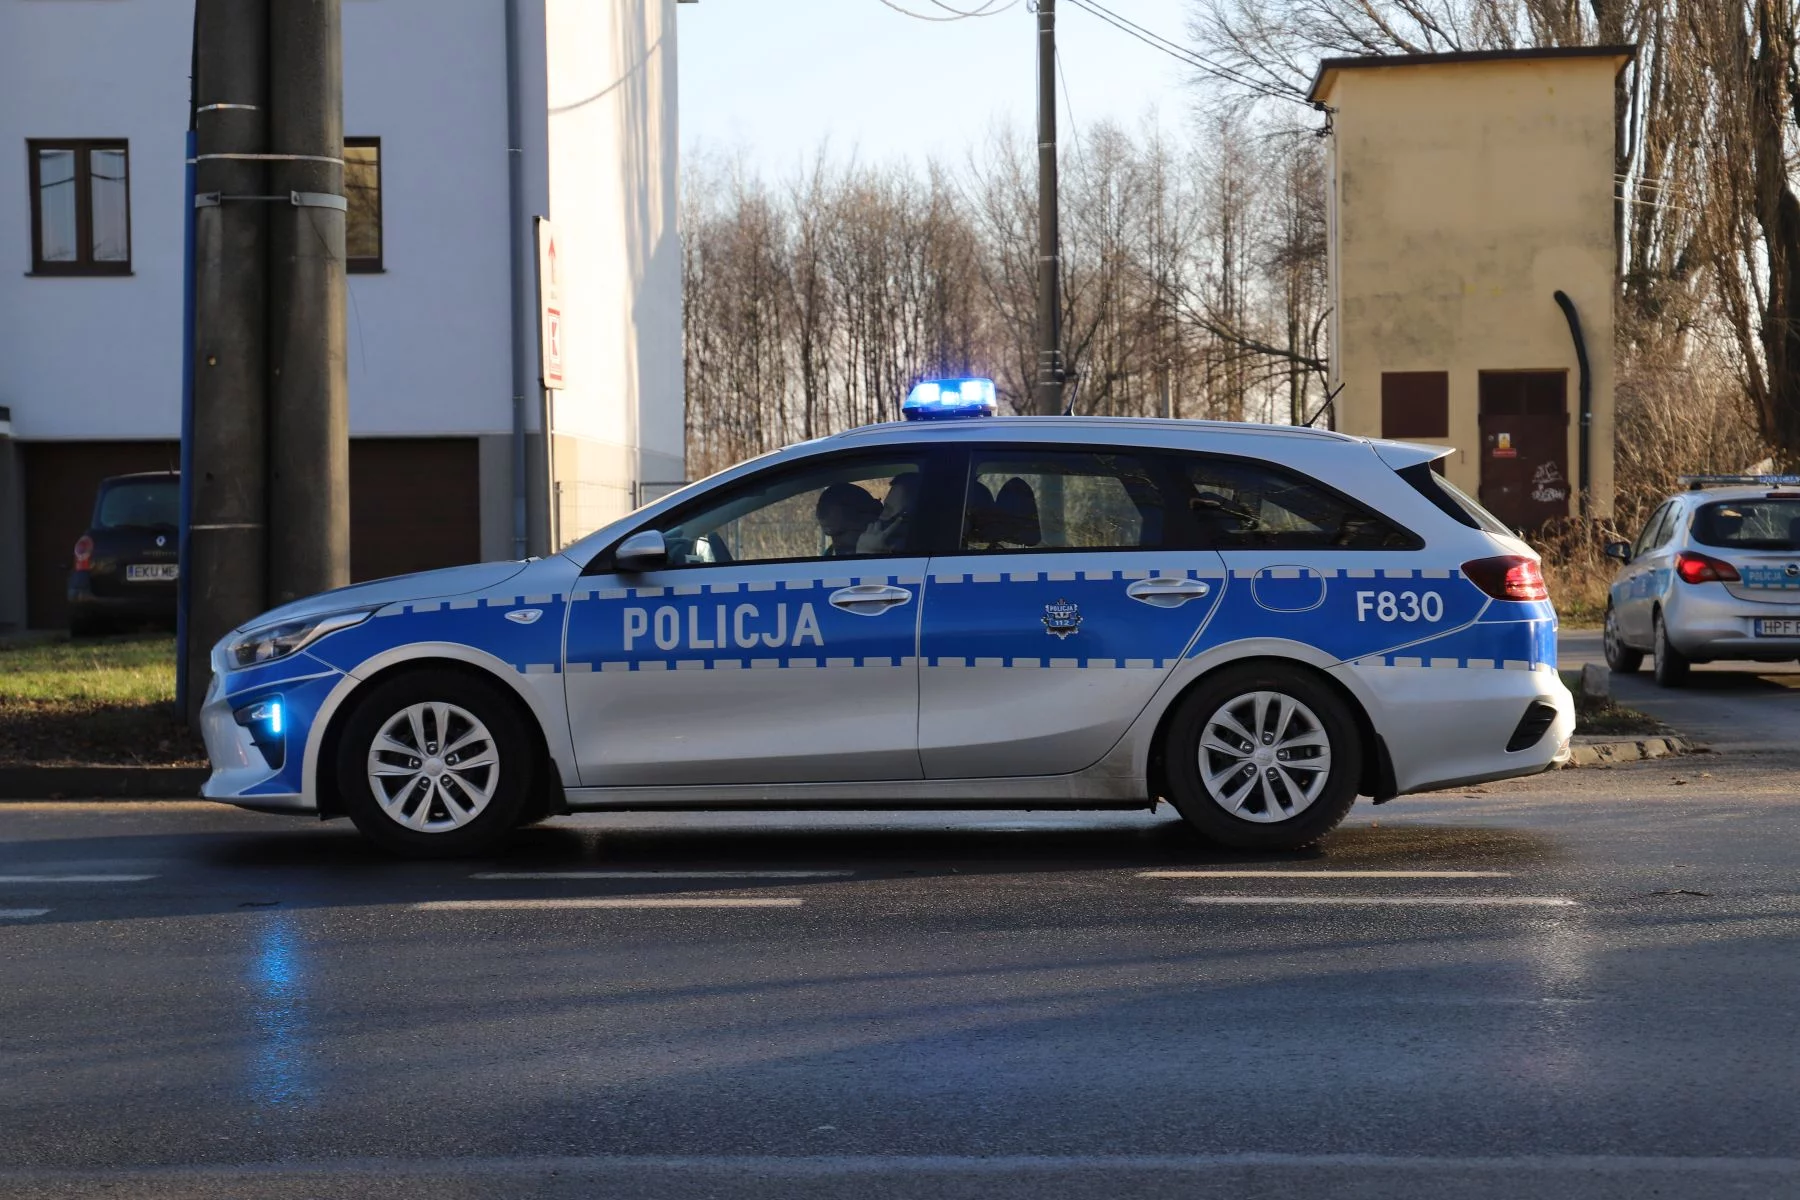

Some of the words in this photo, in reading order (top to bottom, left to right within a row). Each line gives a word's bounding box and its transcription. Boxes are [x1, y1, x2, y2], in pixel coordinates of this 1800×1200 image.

[1749, 571, 1782, 581] POLICJA
[1356, 591, 1444, 622] F830
[623, 602, 824, 651] POLICJA
[1764, 621, 1792, 633] HPF
